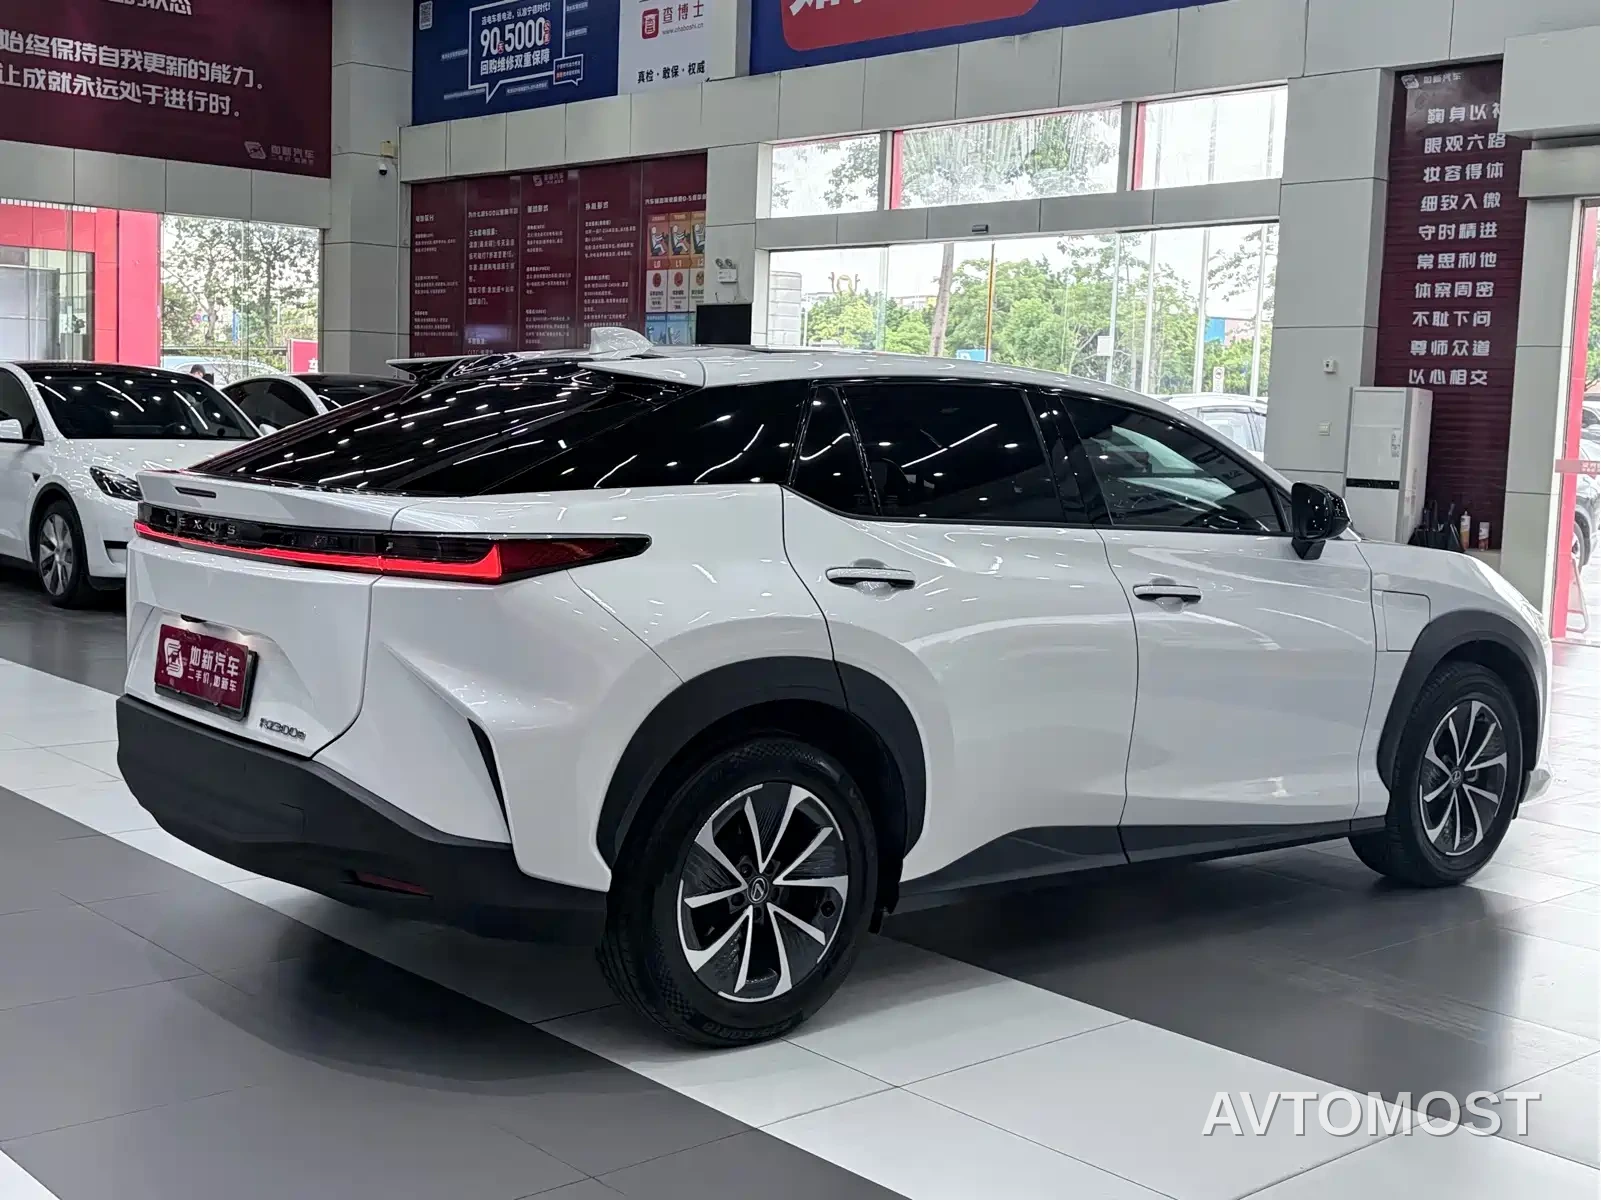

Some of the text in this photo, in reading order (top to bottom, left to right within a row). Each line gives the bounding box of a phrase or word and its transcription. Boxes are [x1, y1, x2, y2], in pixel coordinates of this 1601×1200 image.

[662, 0, 705, 24] 查博士
[0, 28, 264, 89] 始终保持自我更新的能力。
[480, 48, 551, 76] 回购维修双重保障
[1424, 133, 1506, 154] 眼观六路
[1423, 162, 1504, 183] 妆容得体
[1420, 192, 1501, 212] 细致入微
[1418, 222, 1498, 241] 守时精进
[1416, 252, 1497, 270] 常思利他
[1414, 281, 1494, 299] 体察周密
[1412, 310, 1492, 328] 不耻下问
[1410, 339, 1490, 357] 尊师众道
[1408, 368, 1489, 386] 以心相交
[165, 513, 237, 535] LEXUS
[189, 645, 241, 678] 如新汽车
